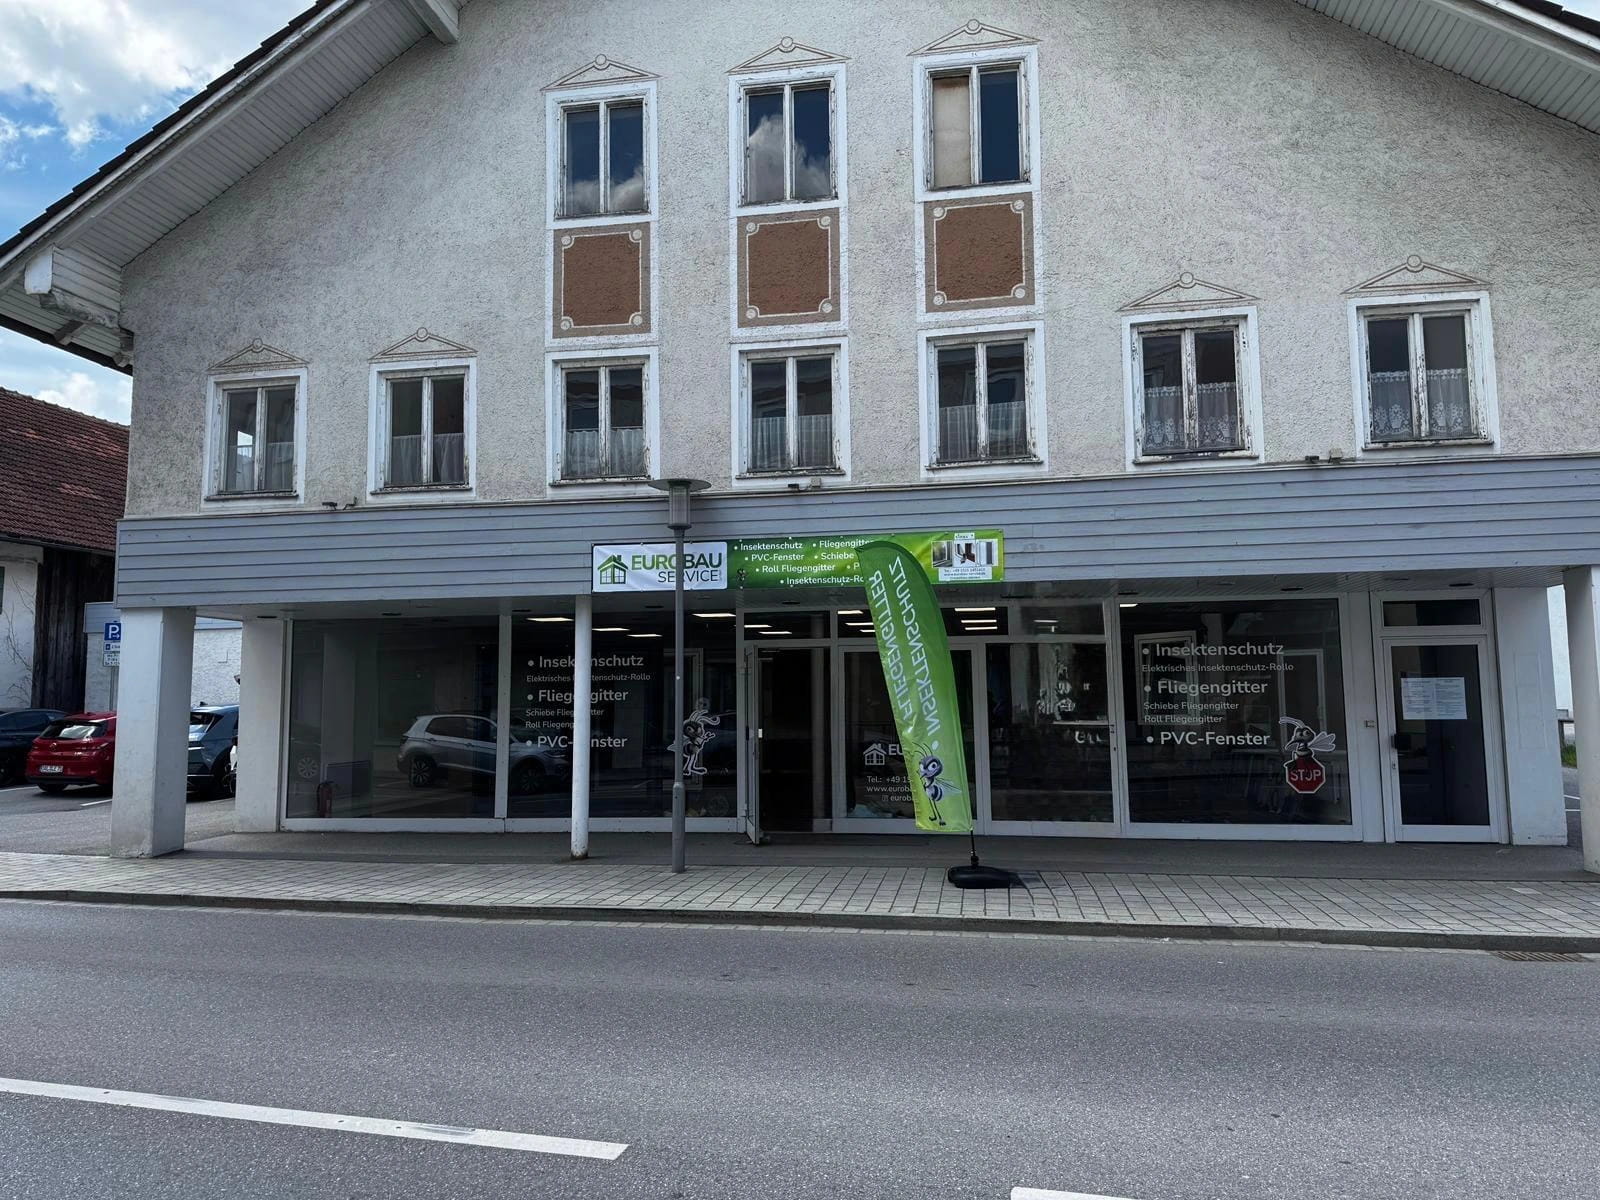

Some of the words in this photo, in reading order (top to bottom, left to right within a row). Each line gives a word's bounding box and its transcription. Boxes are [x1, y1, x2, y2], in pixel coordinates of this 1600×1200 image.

[740, 541, 803, 551] Insektenschutz
[751, 553, 805, 562] PVC-Fenster
[821, 552, 855, 560] Schiebe
[762, 565, 779, 573] Roll
[781, 563, 836, 574] Fliegengitter
[658, 570, 719, 583] SEVICE
[108, 624, 120, 639] P
[1156, 642, 1284, 657] Insektenschutz
[539, 654, 644, 668] Inseknschutz
[1142, 664, 1197, 673] Elektrisches
[1198, 662, 1294, 672] Insektenschutz-Rollo
[526, 674, 571, 682] Elektrisches
[1158, 680, 1268, 696] Fliegengitter
[538, 689, 628, 704] Flieggitter
[1143, 702, 1179, 710] Schiebe
[1181, 701, 1239, 712] Fliegengitter
[526, 708, 555, 717] Schiebe
[1144, 715, 1162, 723] Roll
[1165, 714, 1223, 724] Fliegengitter
[525, 721, 540, 729] Roll
[537, 736, 627, 748] PVC-nster
[1160, 731, 1271, 745] PVC-Fenster
